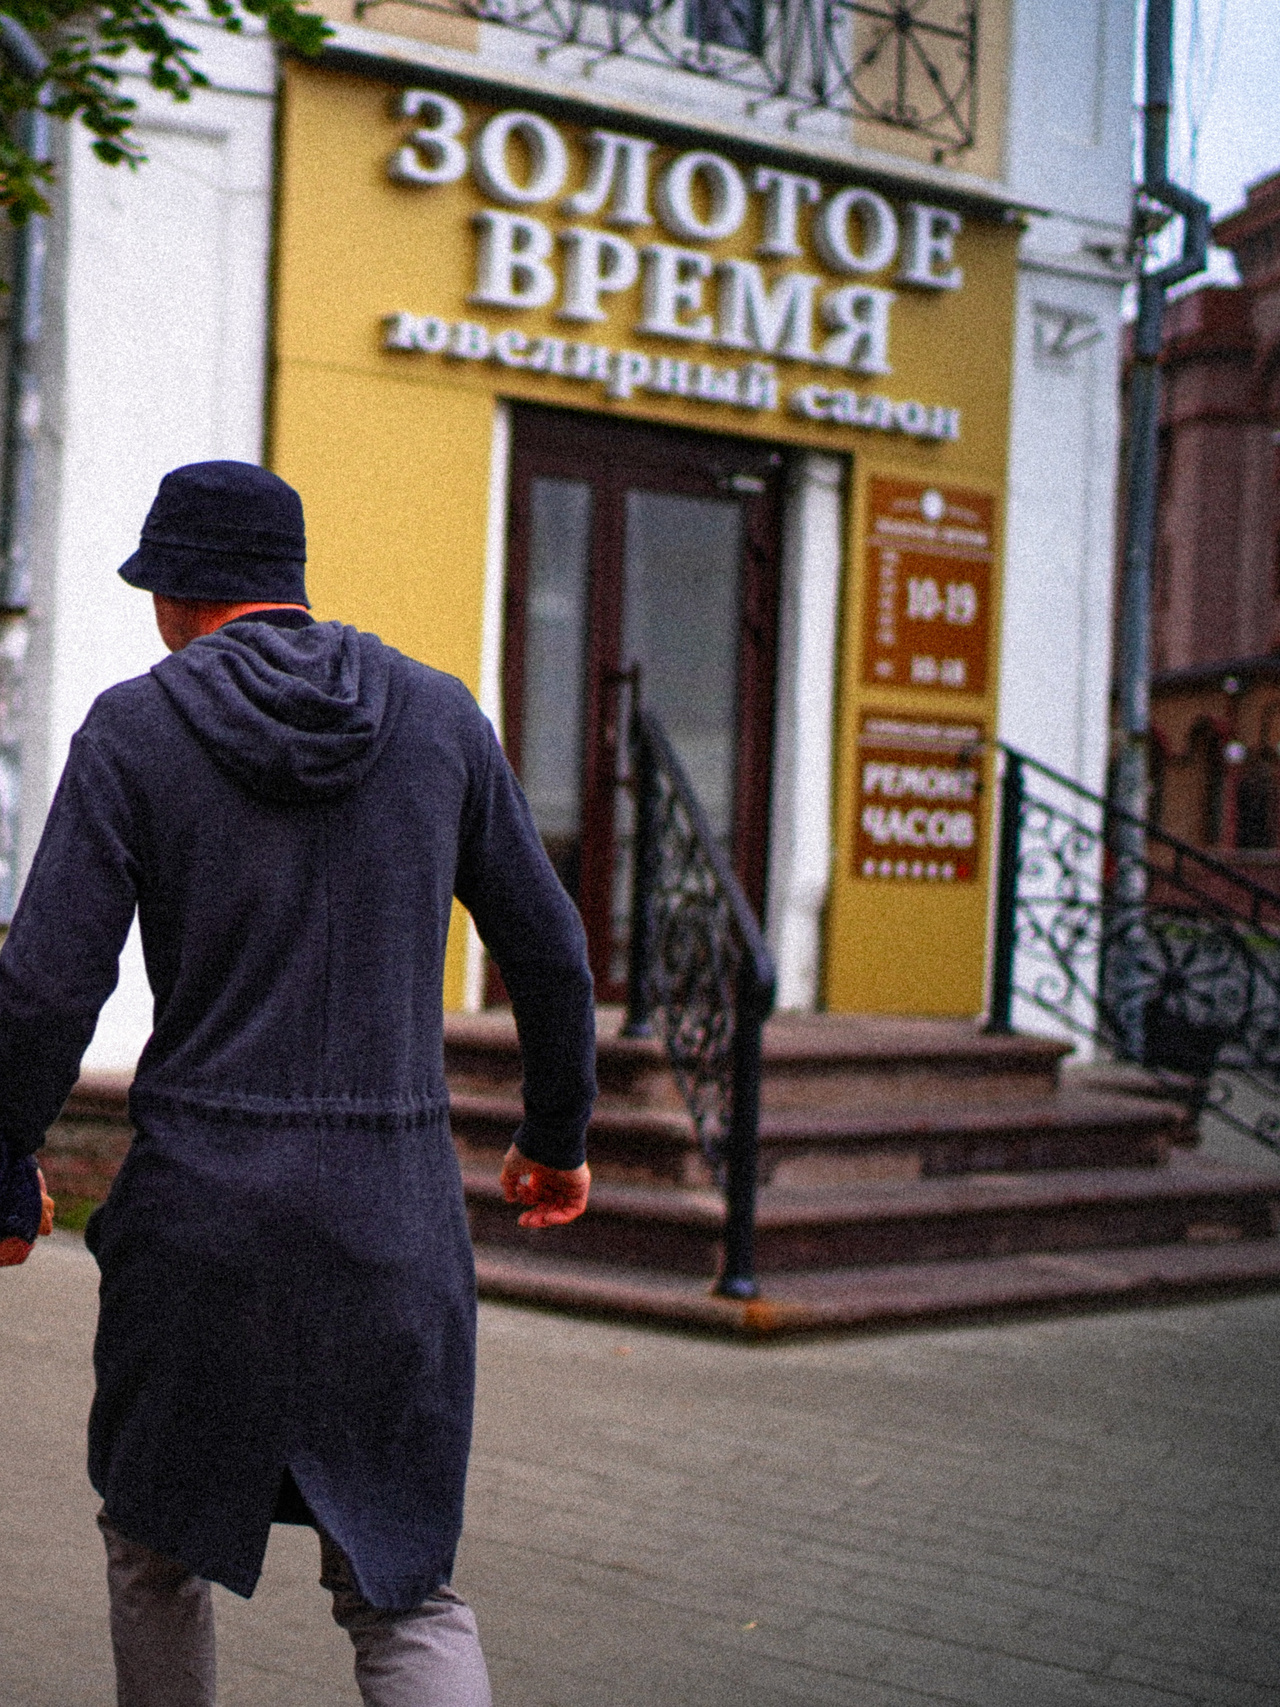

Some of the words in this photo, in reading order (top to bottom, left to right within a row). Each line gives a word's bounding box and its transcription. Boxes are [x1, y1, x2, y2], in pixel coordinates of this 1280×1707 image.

[398, 87, 963, 291] ЗОЛОТОЕ
[467, 207, 896, 375] ВРЕМЯ
[385, 311, 778, 412] ювелирный
[792, 382, 961, 441] салон
[862, 806, 975, 848] ЧАСОВ
